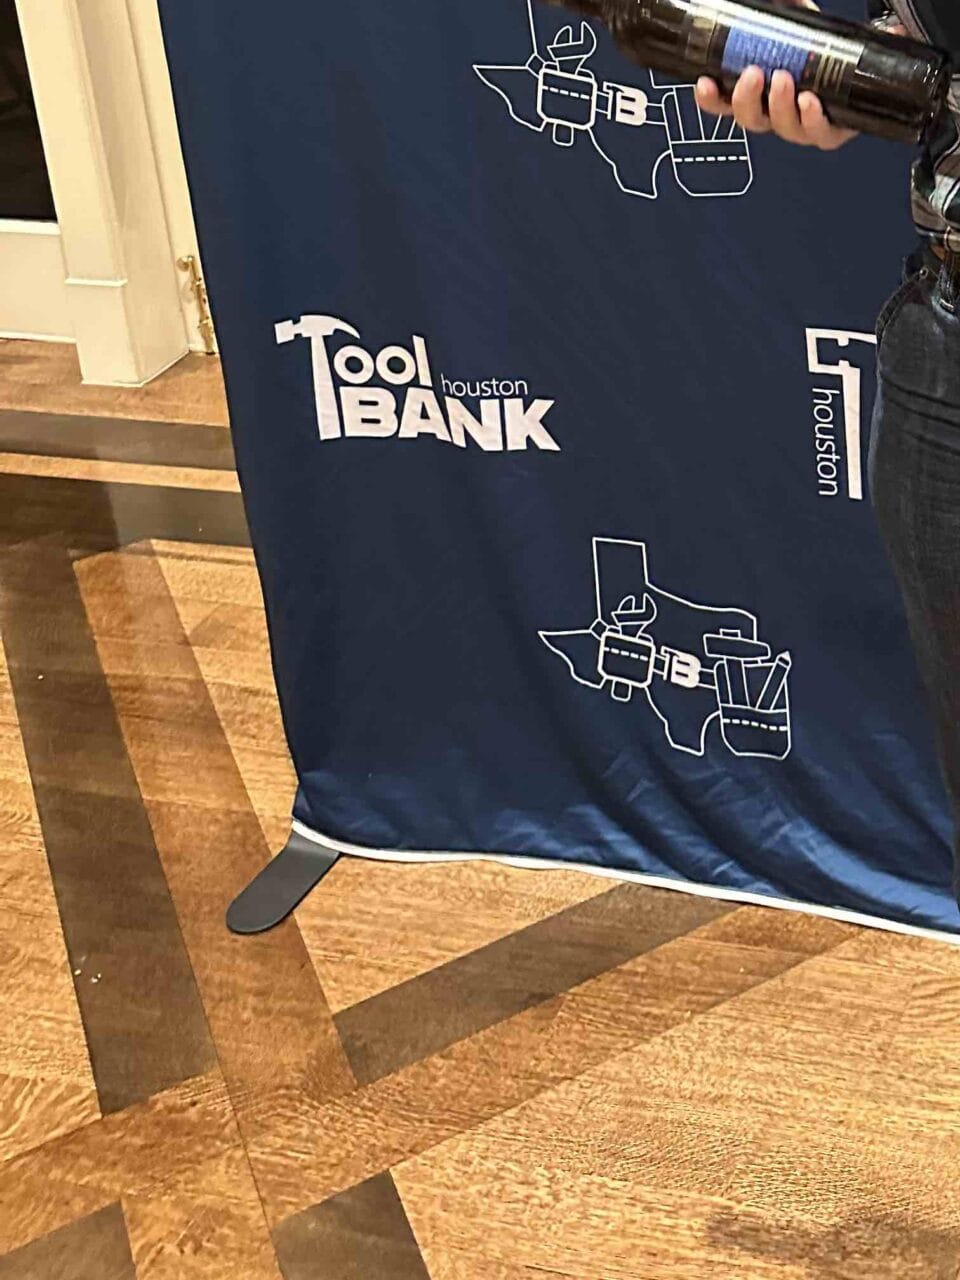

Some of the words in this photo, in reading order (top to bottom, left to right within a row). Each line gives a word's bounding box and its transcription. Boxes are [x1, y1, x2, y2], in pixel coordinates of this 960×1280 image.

[274, 314, 433, 441] Tool
[339, 386, 562, 452] BANK
[440, 373, 528, 397] houston
[812, 388, 841, 496] houston
